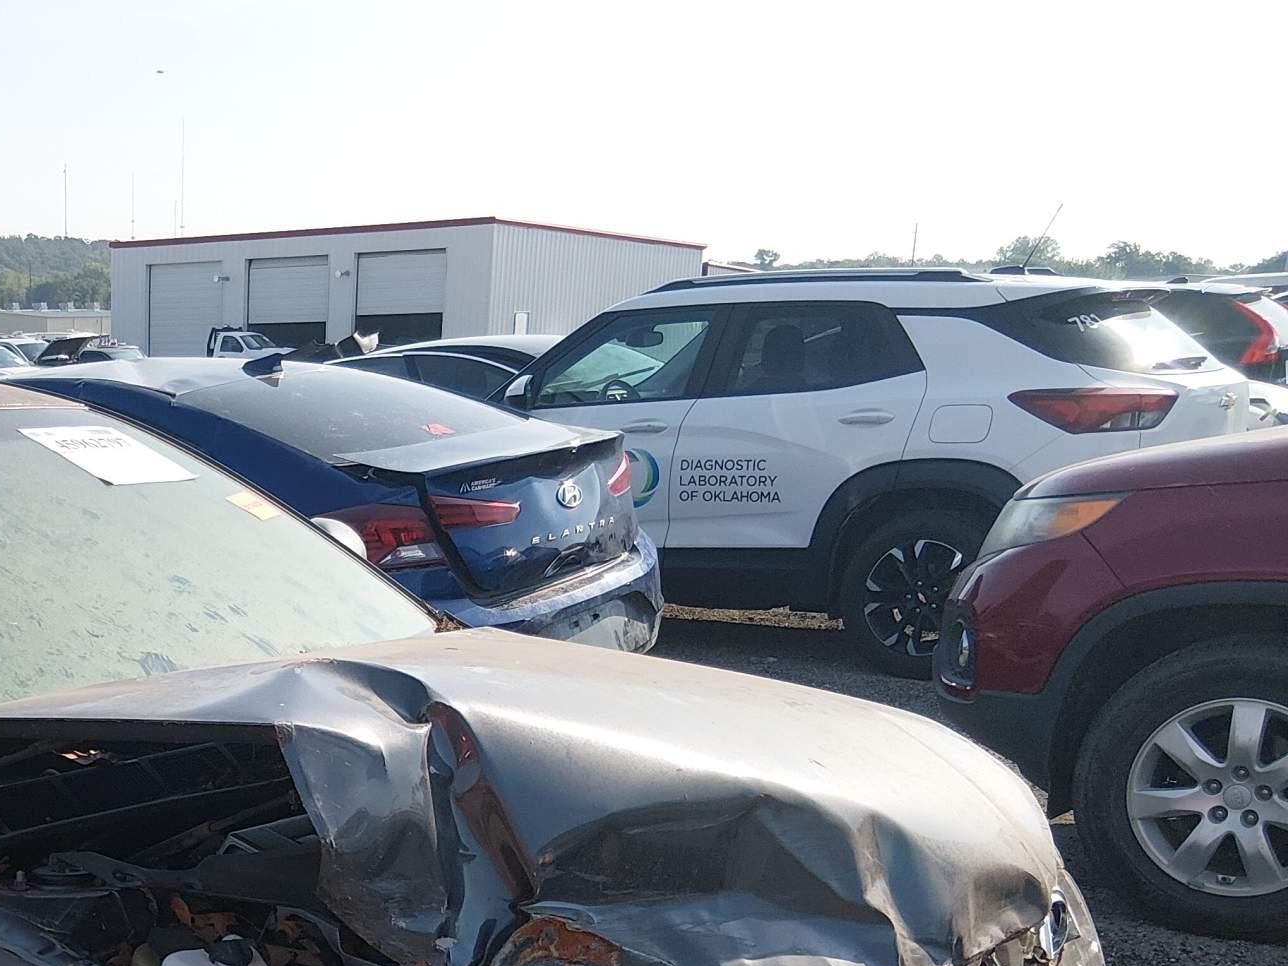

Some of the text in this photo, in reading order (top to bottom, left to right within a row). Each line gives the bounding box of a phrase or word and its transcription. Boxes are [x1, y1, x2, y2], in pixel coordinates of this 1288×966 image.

[680, 459, 767, 471] DIAGNOSTIC
[679, 475, 778, 487] LABORATORY
[679, 490, 781, 503] OF OKLAHOMA
[531, 516, 615, 545] ELANTRA
